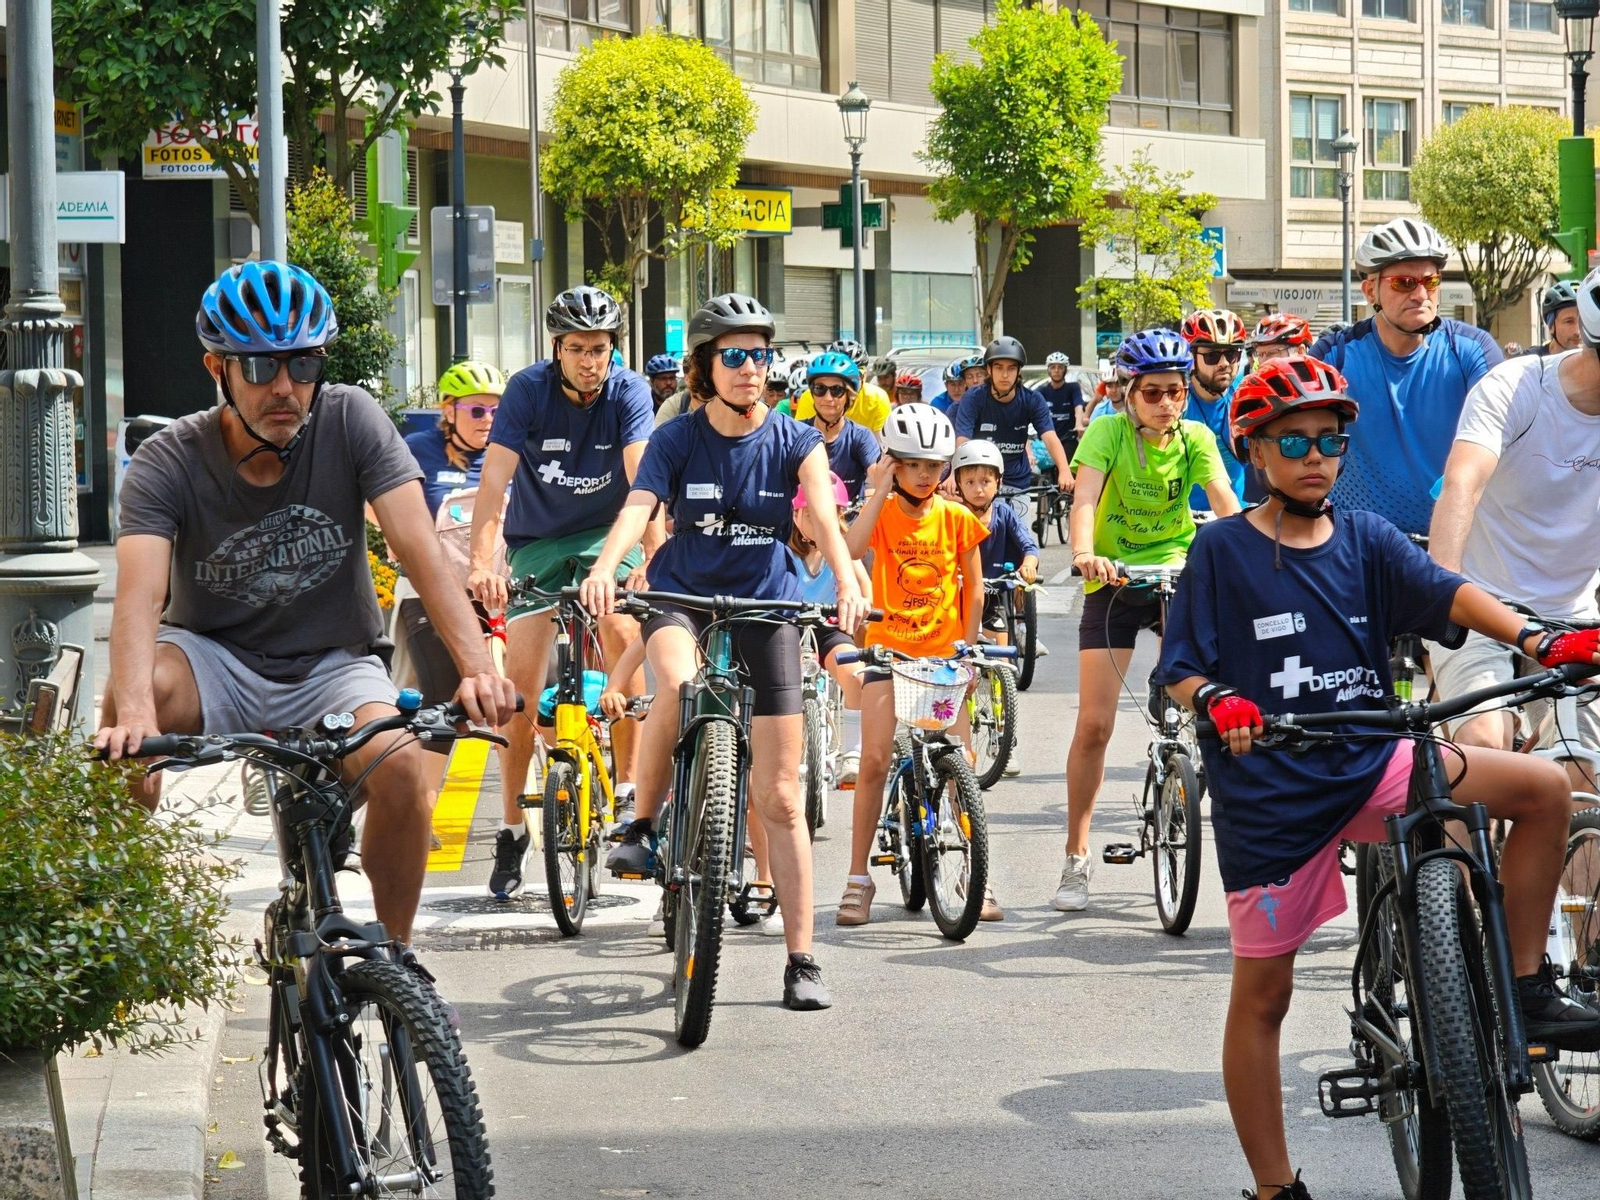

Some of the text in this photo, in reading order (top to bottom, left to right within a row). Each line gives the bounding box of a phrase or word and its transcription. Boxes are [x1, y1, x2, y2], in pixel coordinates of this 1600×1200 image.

[150, 149, 203, 161] FOTOS
[57, 201, 109, 212] ADEMIA
[557, 471, 612, 487] DEPORTE
[573, 479, 612, 495] Atlántico
[1128, 480, 1164, 491] CONCELLO
[730, 535, 774, 546] Atlántico
[1257, 617, 1290, 629] CONCELLO
[1271, 625, 1287, 633] VIGO
